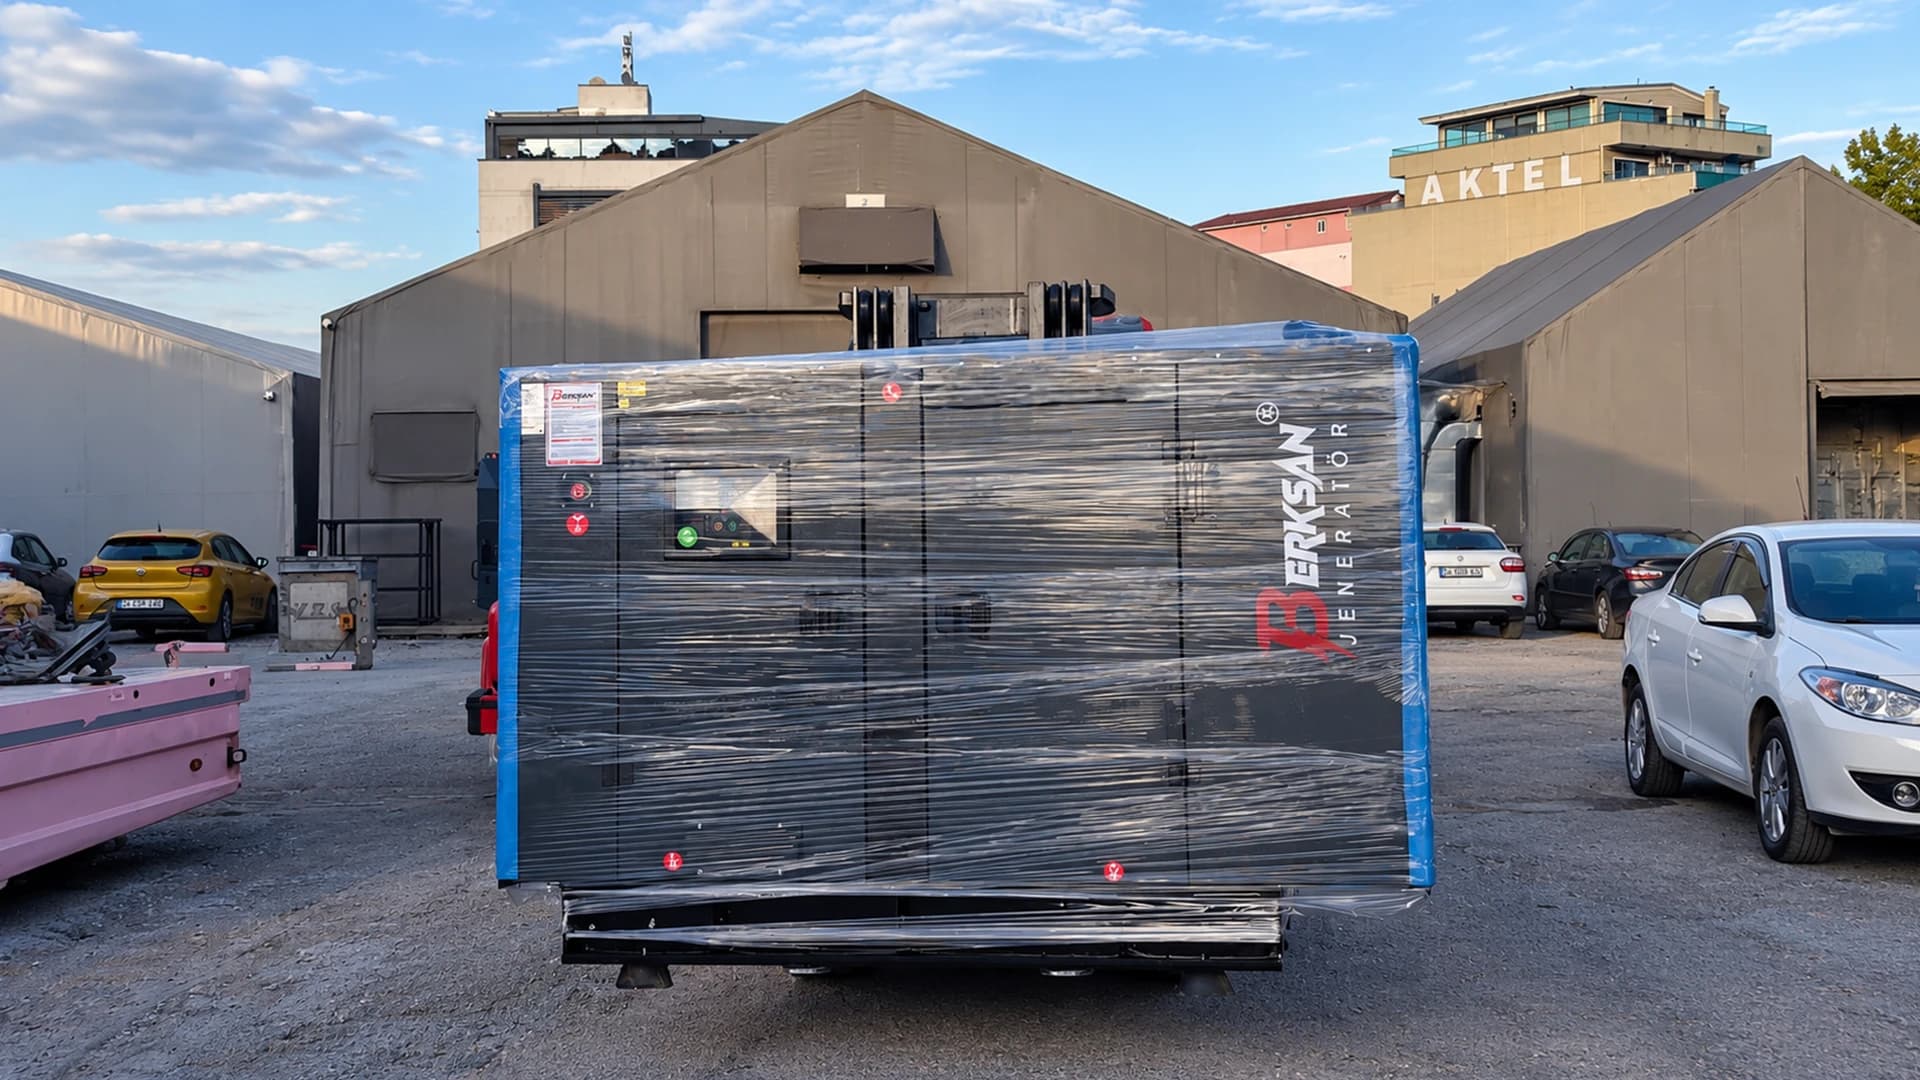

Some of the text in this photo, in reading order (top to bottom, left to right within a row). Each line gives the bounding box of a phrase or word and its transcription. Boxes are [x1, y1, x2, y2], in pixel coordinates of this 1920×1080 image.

[1421, 155, 1582, 205] AKTEL
[1256, 422, 1338, 663] BERKSAN
[1327, 423, 1357, 645] JENERATÖR
